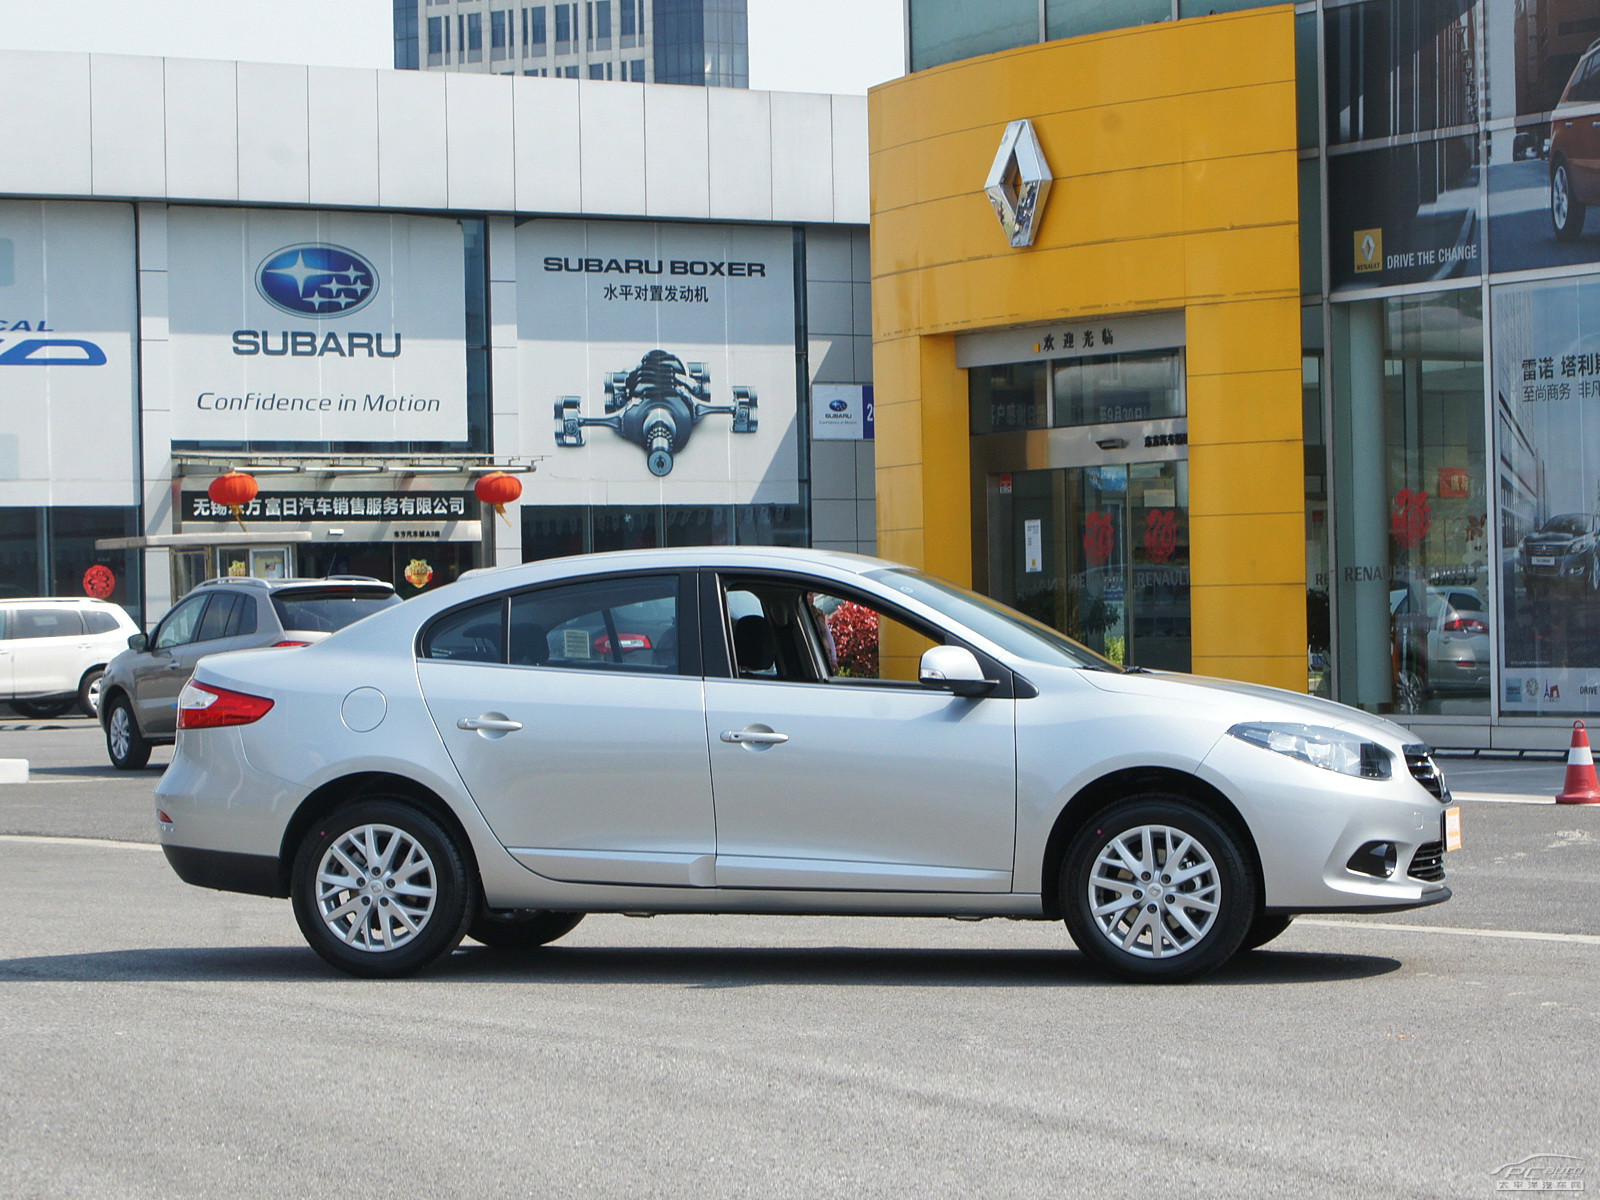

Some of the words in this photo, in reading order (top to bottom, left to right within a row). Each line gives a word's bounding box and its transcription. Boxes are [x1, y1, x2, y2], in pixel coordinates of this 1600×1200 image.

[543, 257, 663, 275] SUBARU
[670, 260, 766, 277] BOXER
[1356, 262, 1381, 271] RENAULT
[1387, 252, 1415, 270] DRIVE
[1417, 249, 1436, 266] THE
[1438, 244, 1478, 263] CHANGE
[603, 283, 709, 303] 水平对置发动机
[232, 330, 402, 358] SUBARU
[1043, 327, 1114, 351] 欢迎光临
[1522, 356, 1554, 381] 雷诺
[197, 392, 332, 411] Confidence
[338, 394, 356, 411] in
[362, 394, 441, 412] Motion
[1523, 382, 1571, 402] 至尚商务
[193, 496, 465, 516] 无锡方富日汽车销售服务有限公司
[1580, 684, 1598, 695] DRIVE
